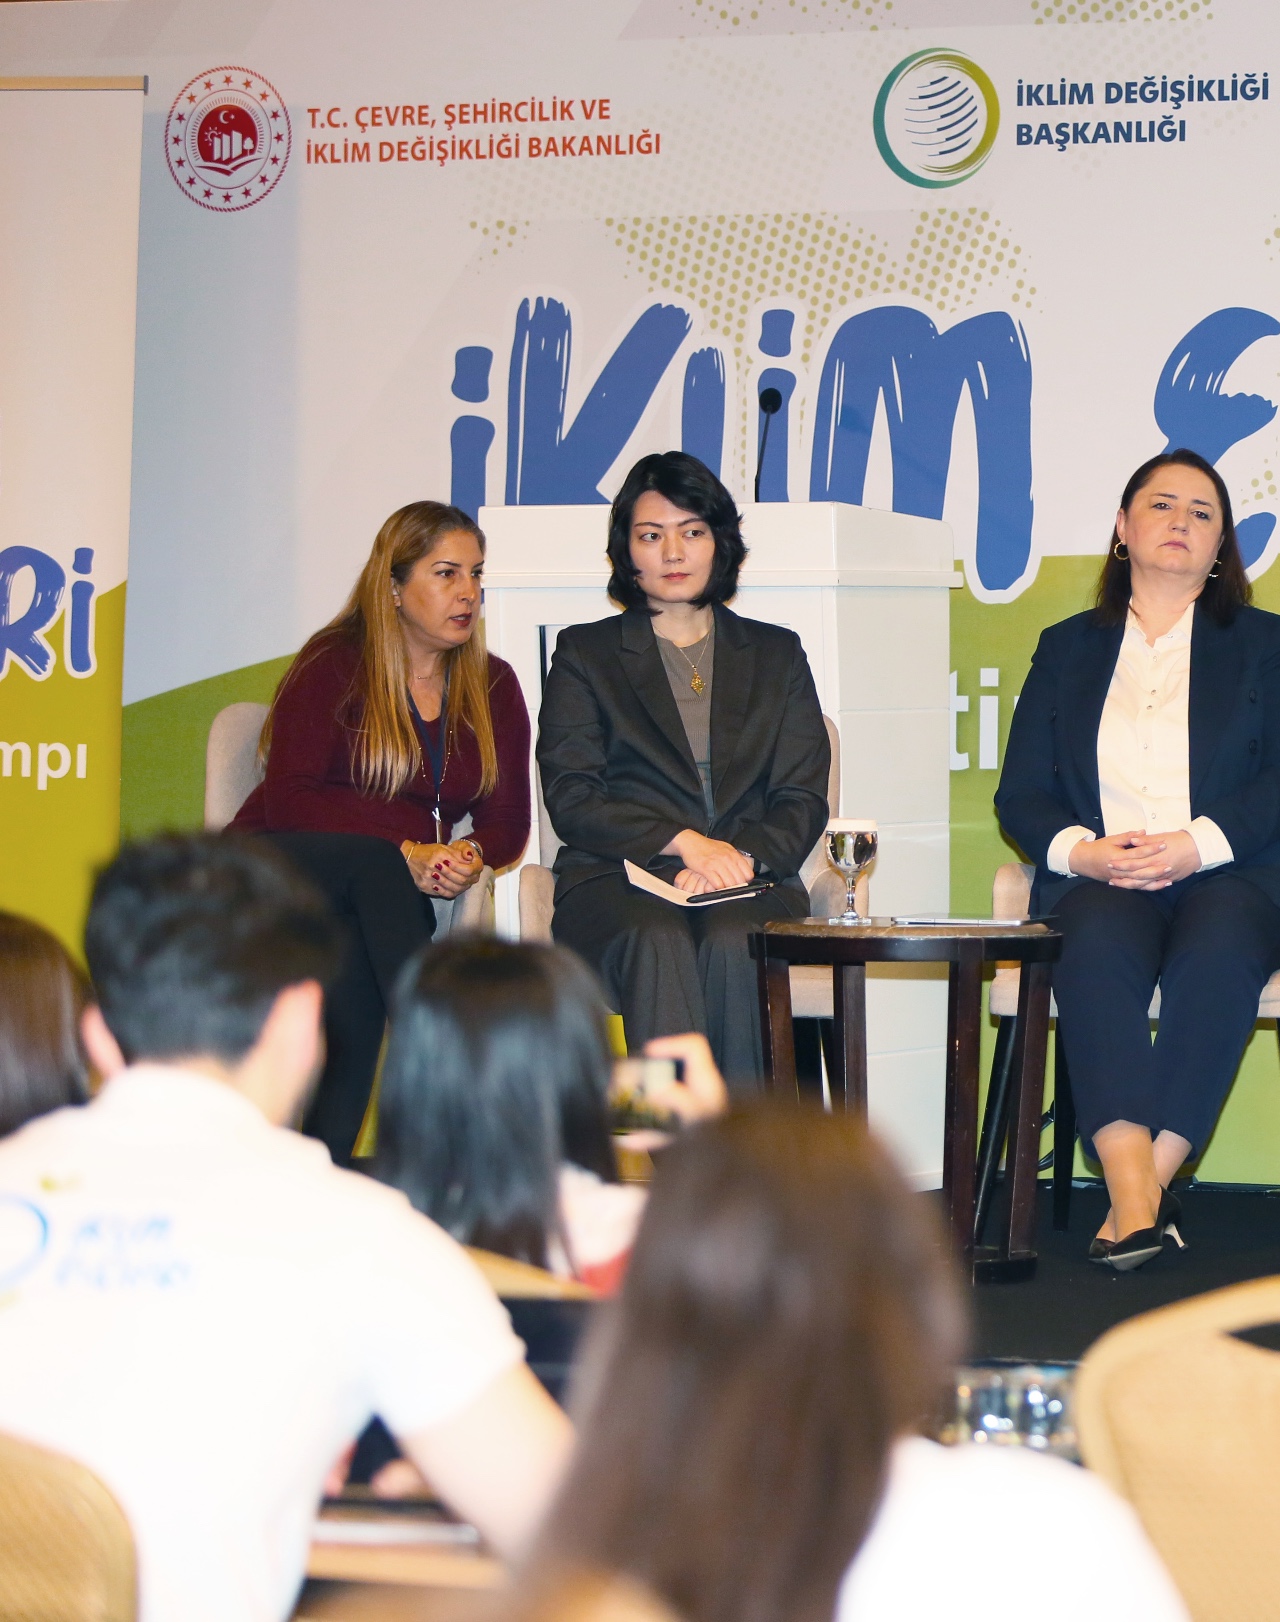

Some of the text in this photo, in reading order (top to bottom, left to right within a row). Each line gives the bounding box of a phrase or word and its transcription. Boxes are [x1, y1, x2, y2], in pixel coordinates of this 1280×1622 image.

[1016, 72, 1270, 109] İKLİM DEĞİŞİKLİĞİ
[307, 95, 611, 133] T.C. ÇEVRE, ŞEHİRCİLİK VE
[1016, 114, 1187, 151] BAŞKANLIĞI
[306, 128, 662, 167] İKLİM DEĞİŞİKLİĞİ BAKANLIĞI
